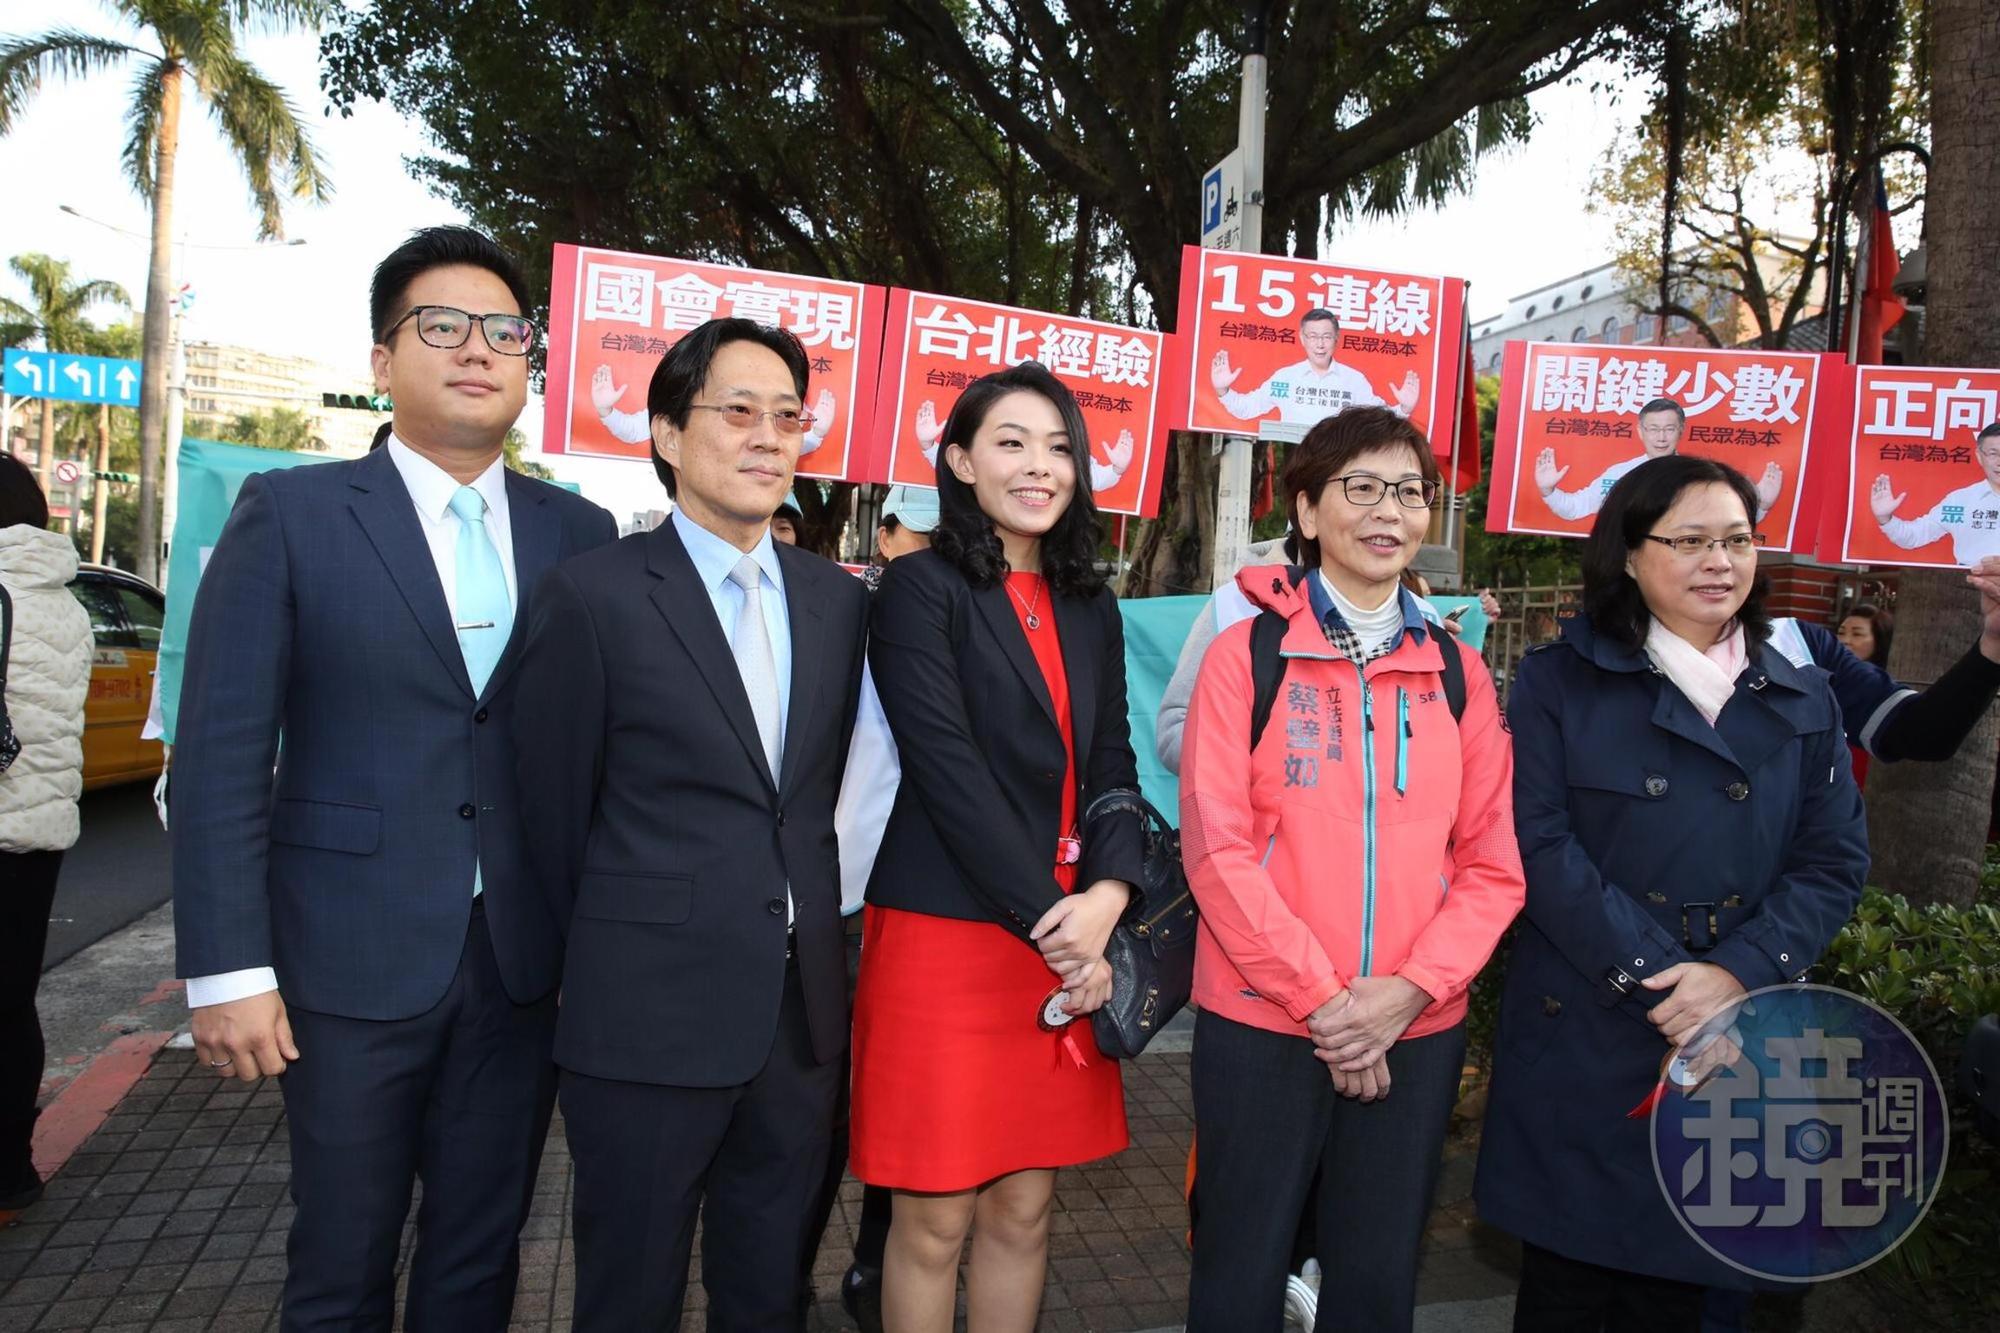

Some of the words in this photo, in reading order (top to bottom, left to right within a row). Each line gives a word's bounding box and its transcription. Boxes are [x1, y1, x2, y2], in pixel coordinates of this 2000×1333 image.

[584, 262, 854, 350] 國會實現
[601, 332, 676, 356] 台灣為
[915, 304, 1153, 388] 台北經驗
[1219, 321, 1296, 345] 台灣為名
[1342, 334, 1417, 357] 民眾為本
[1070, 390, 1133, 413] 眾為本
[1531, 355, 1804, 424] 關鍵少數
[1863, 377, 2000, 441] 正向
[1545, 417, 1633, 439] 台灣為名
[1688, 425, 1782, 447] 民眾為本
[1879, 443, 1971, 464] 台灣為名
[1940, 505, 1964, 523] 眾
